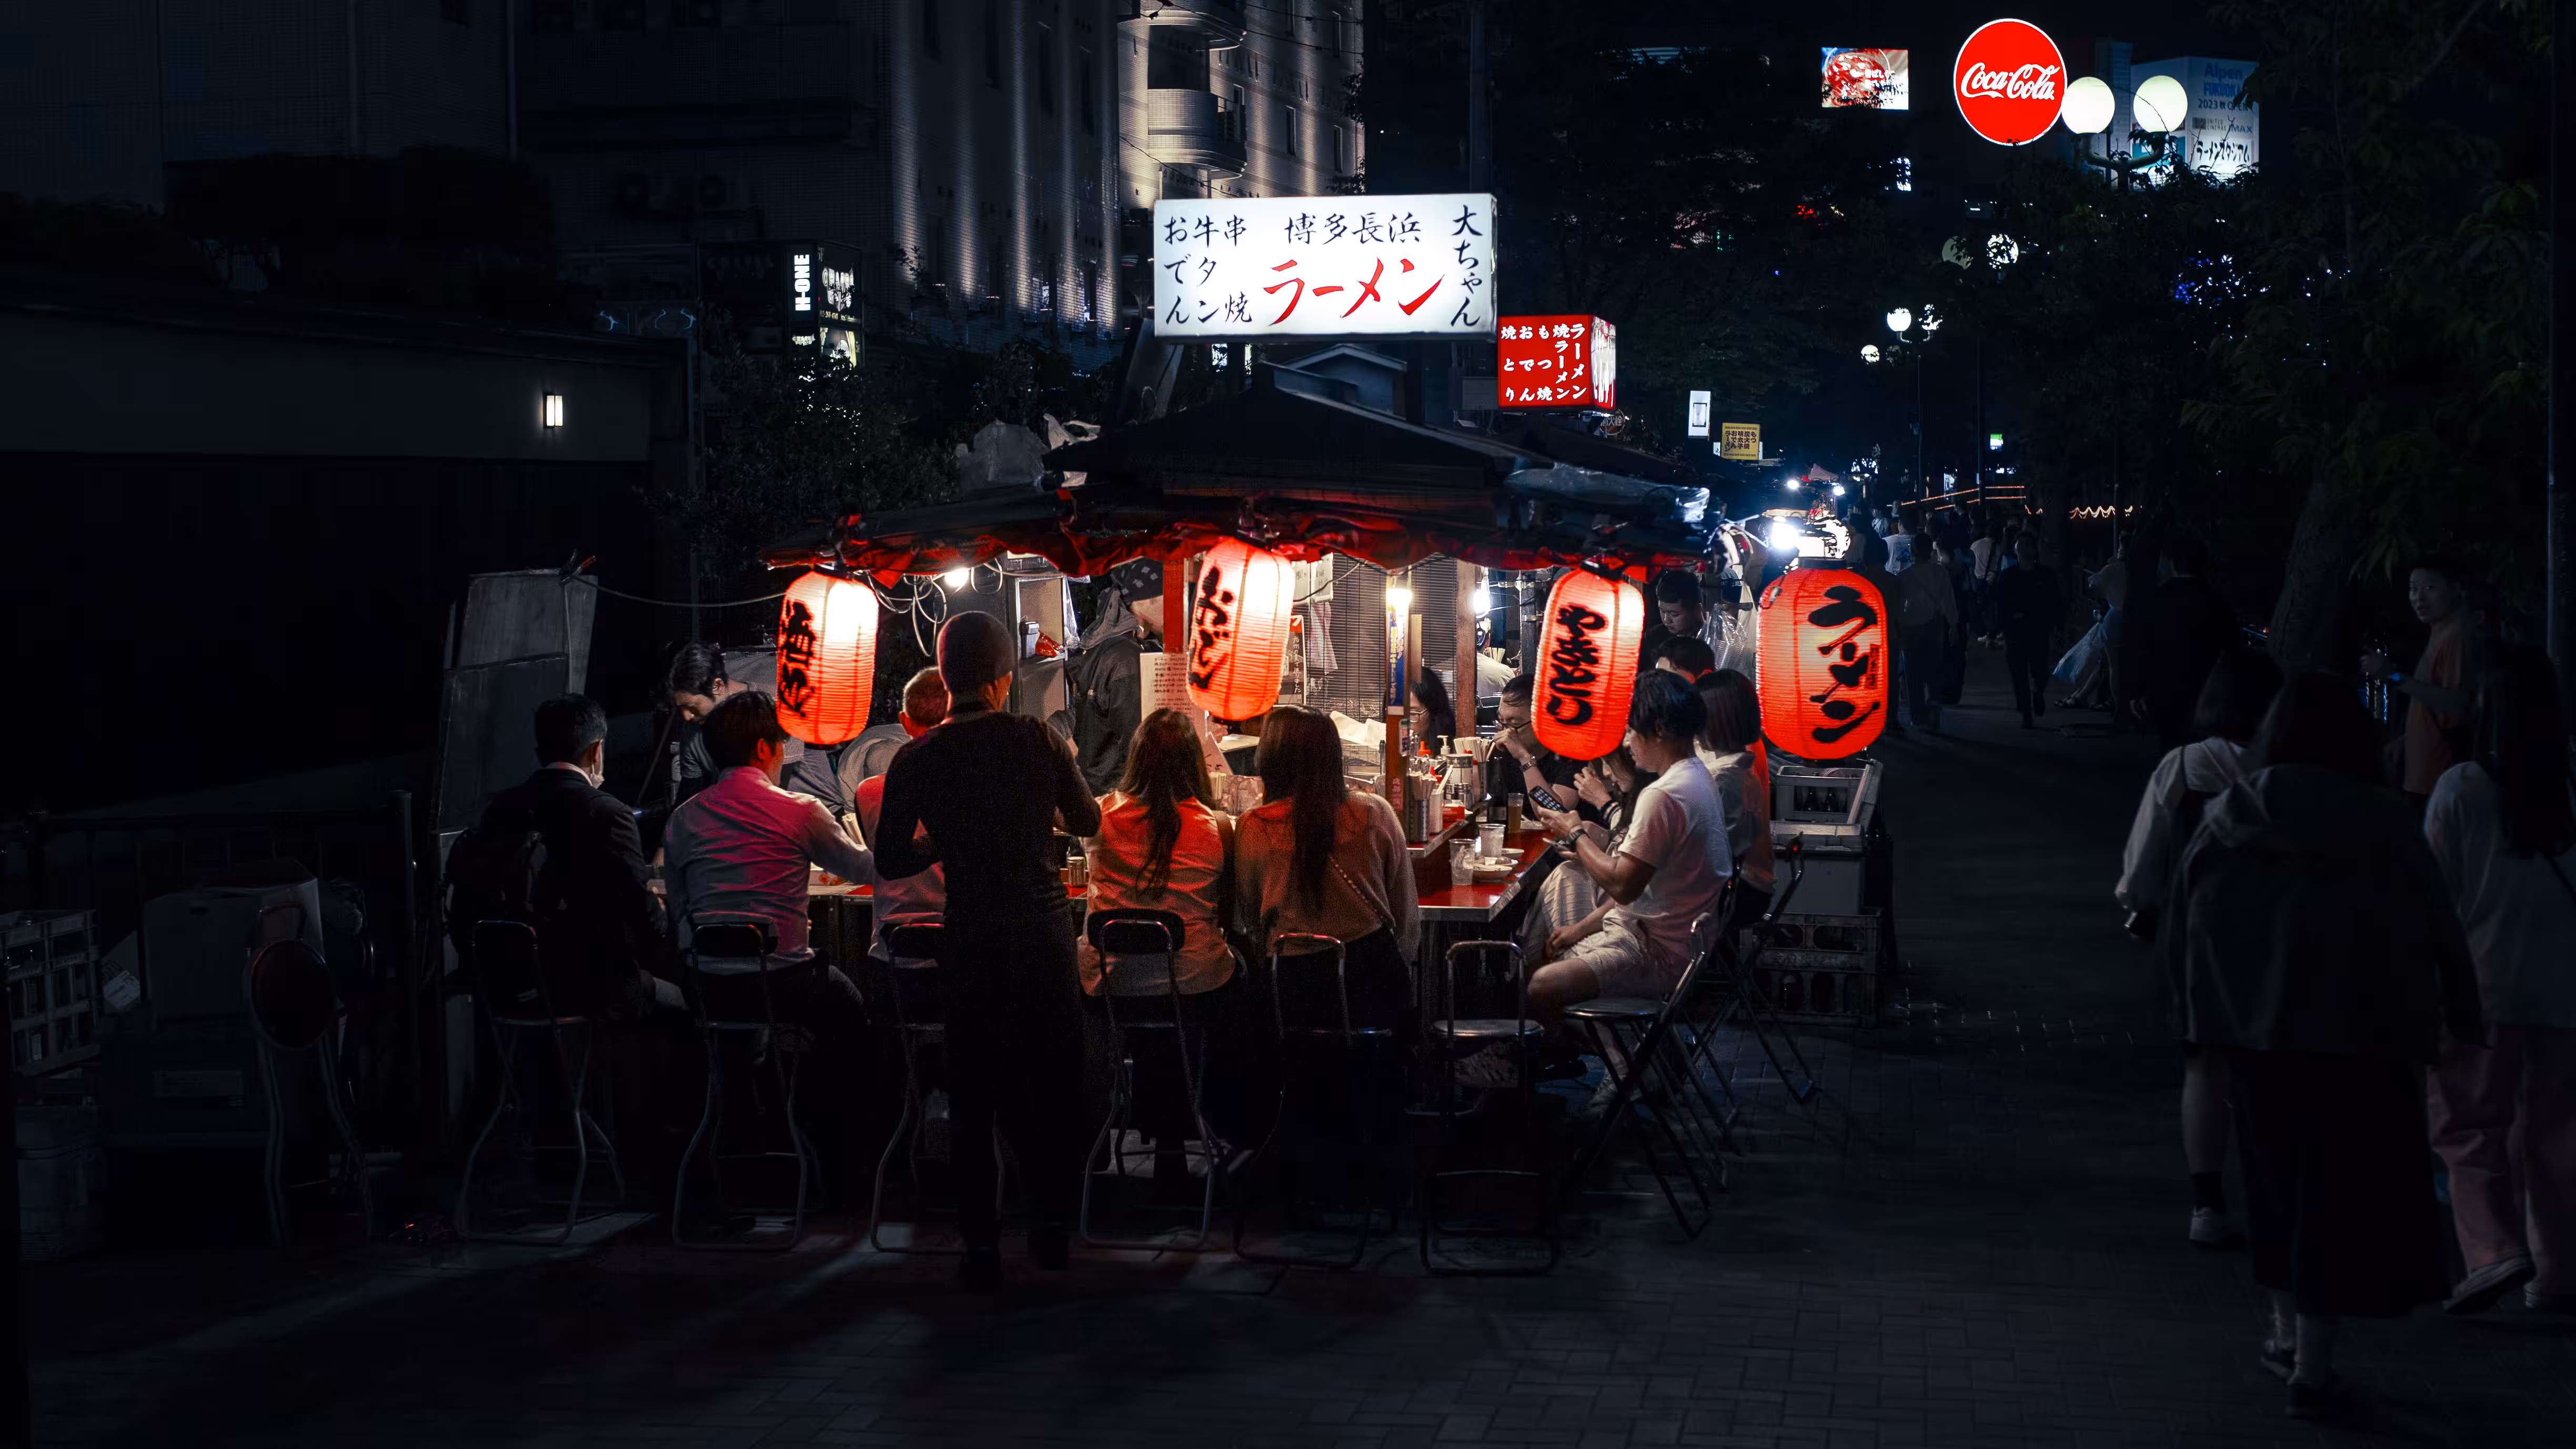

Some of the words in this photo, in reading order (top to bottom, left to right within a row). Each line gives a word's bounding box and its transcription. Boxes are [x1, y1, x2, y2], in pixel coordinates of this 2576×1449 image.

[1960, 62, 2061, 100] Coca-Cola
[2205, 62, 2243, 81] Alpen
[2227, 101, 2249, 111] OEN
[1284, 212, 1421, 245] 博多長浜
[1450, 204, 1483, 327] 大ちゃん
[794, 254, 811, 311] H-ONE
[1164, 216, 1190, 325] おでん
[1192, 214, 1220, 321] 牛タン
[1223, 213, 1252, 324] 串焼
[1263, 257, 1445, 326] ラーメン
[1501, 325, 1517, 402] 焼とり
[1518, 325, 1535, 401] おでん
[1537, 325, 1553, 401] もつ焼
[1553, 323, 1571, 399] 焼ラーメン
[1570, 323, 1587, 399] ラーメン
[1188, 566, 1233, 690] おでん
[1546, 603, 1606, 726] やきとり
[1807, 585, 1881, 744] ラーメン
